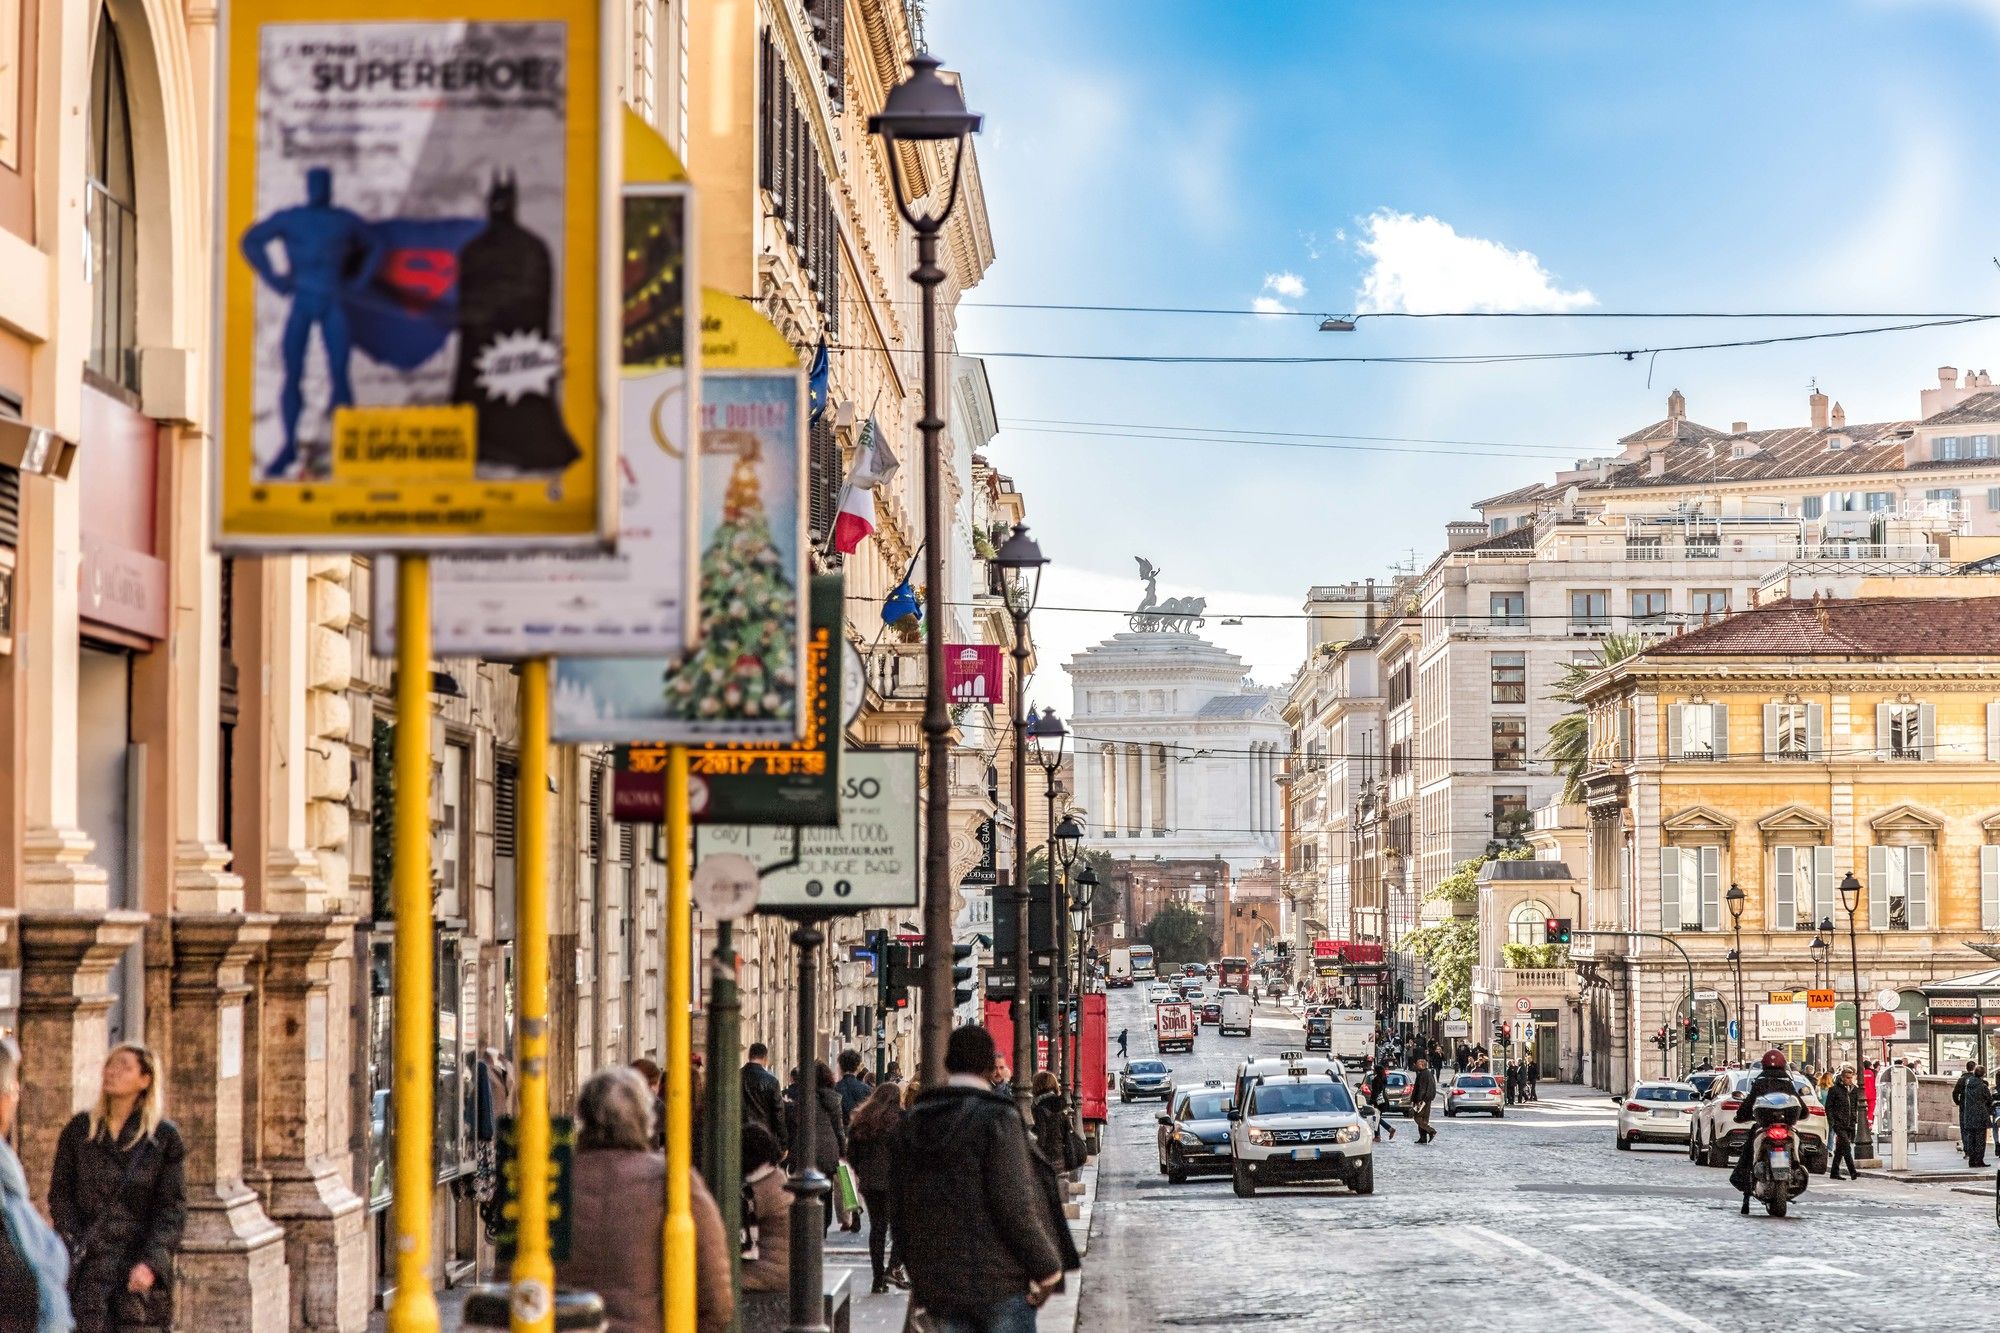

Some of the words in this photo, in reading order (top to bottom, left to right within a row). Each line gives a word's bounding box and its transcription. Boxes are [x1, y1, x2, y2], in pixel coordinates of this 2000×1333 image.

[779, 846, 822, 856] ITIAN
[825, 846, 894, 856] RESTAURANT
[1810, 994, 1833, 1003] TAXI
[1519, 1001, 1528, 1009] 30
